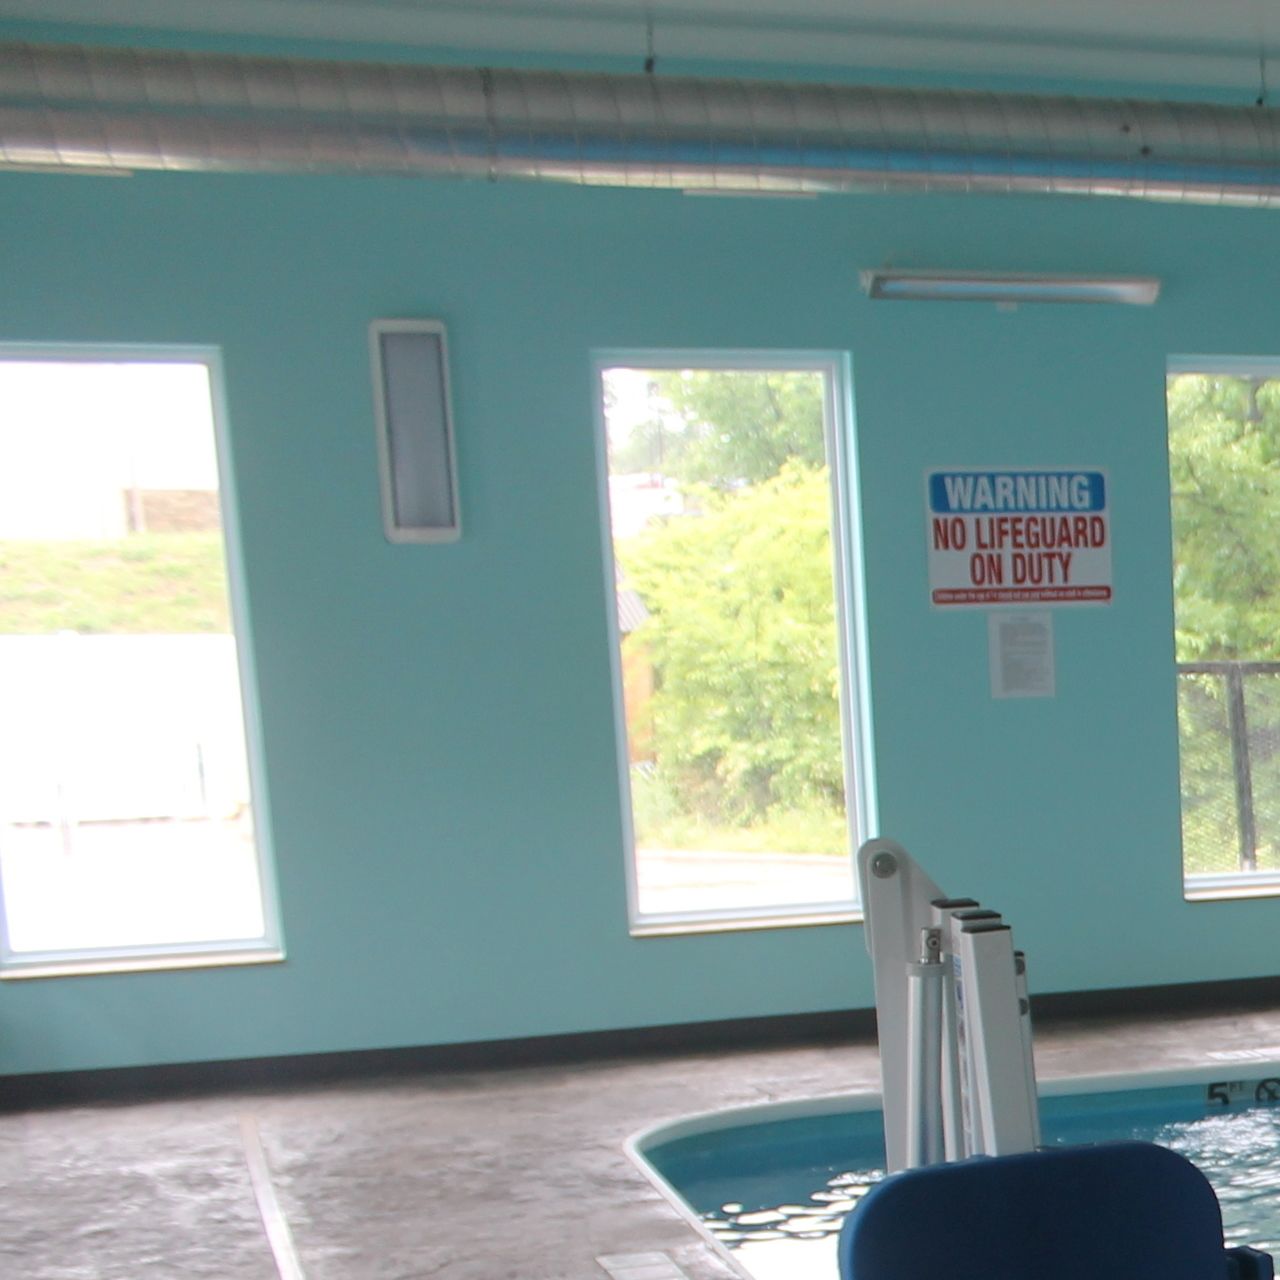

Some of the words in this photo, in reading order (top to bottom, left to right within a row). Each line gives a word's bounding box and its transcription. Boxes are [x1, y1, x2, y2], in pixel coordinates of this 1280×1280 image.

[944, 475, 1091, 510] WARNING
[933, 517, 966, 550] NO
[975, 515, 1105, 549] LIFEGUARD
[970, 552, 1002, 585] ON
[1012, 551, 1073, 584] DUTY
[1207, 1082, 1230, 1105] 5
